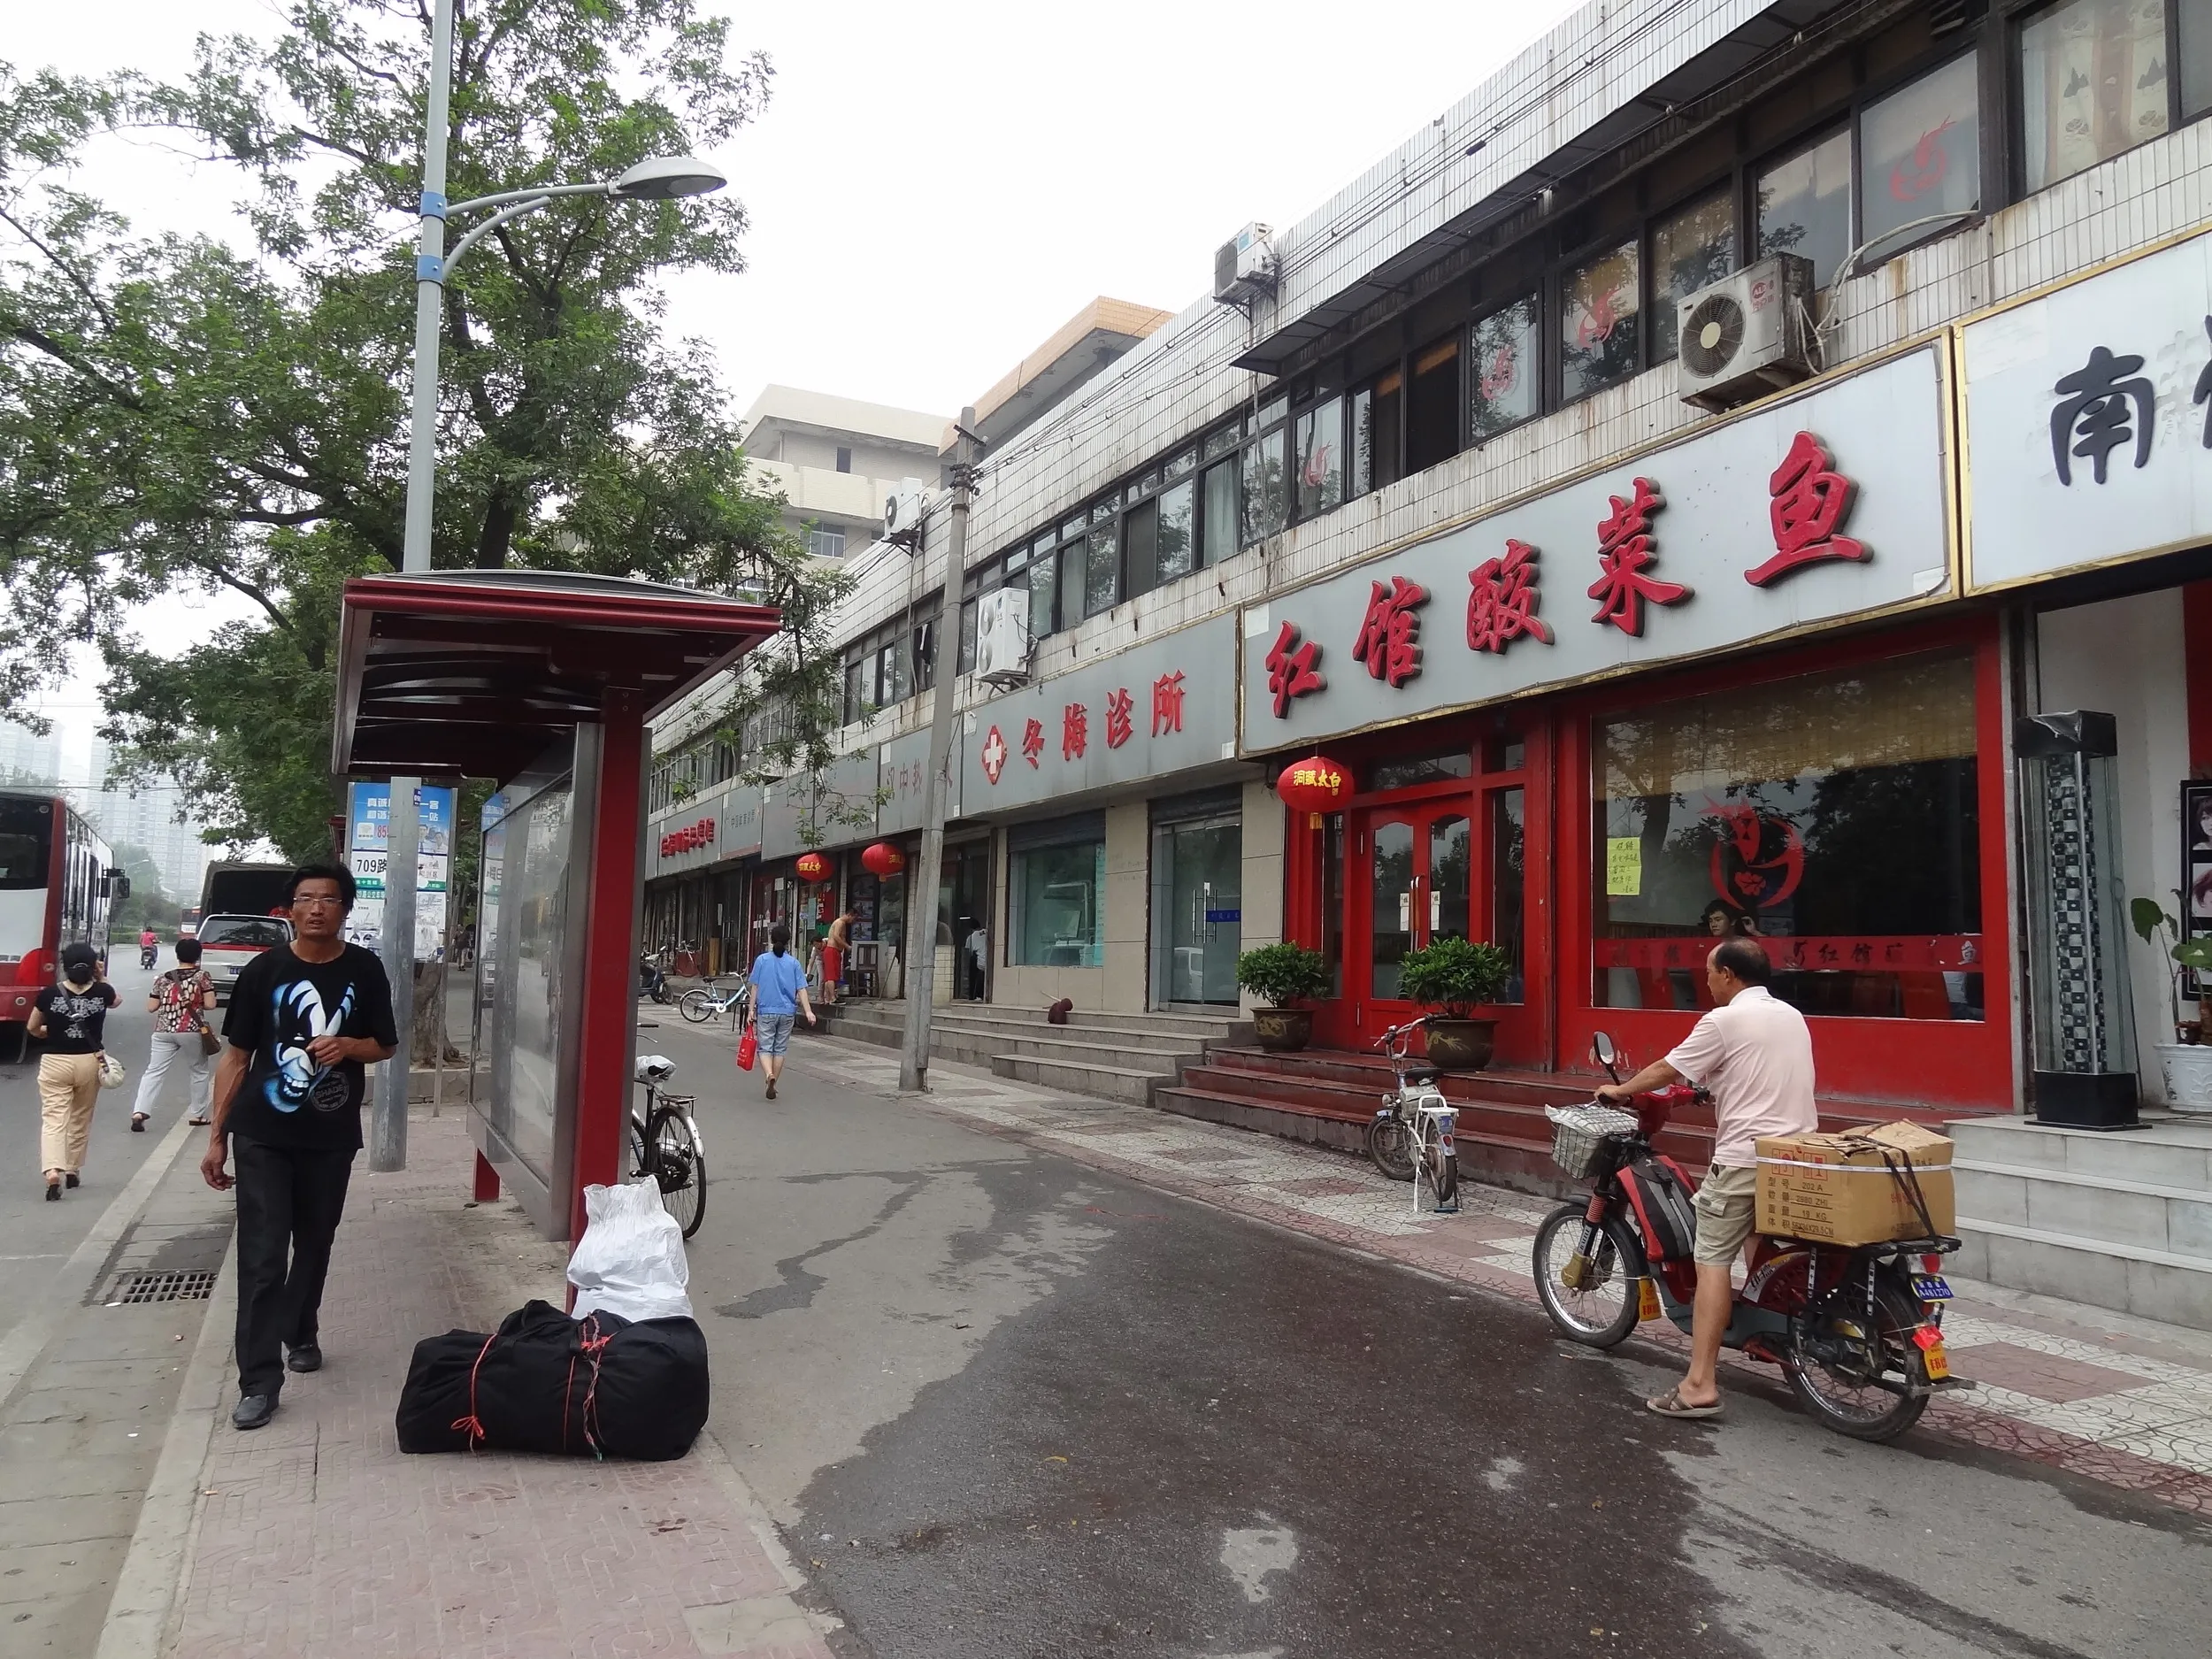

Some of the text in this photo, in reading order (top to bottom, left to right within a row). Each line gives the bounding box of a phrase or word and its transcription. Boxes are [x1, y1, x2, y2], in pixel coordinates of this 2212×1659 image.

[1264, 430, 1874, 719] 红馆酸菜鱼
[1022, 669, 1186, 770] 冬梅诊所
[357, 858, 387, 873] 709路
[1816, 1212, 1827, 1221] KG
